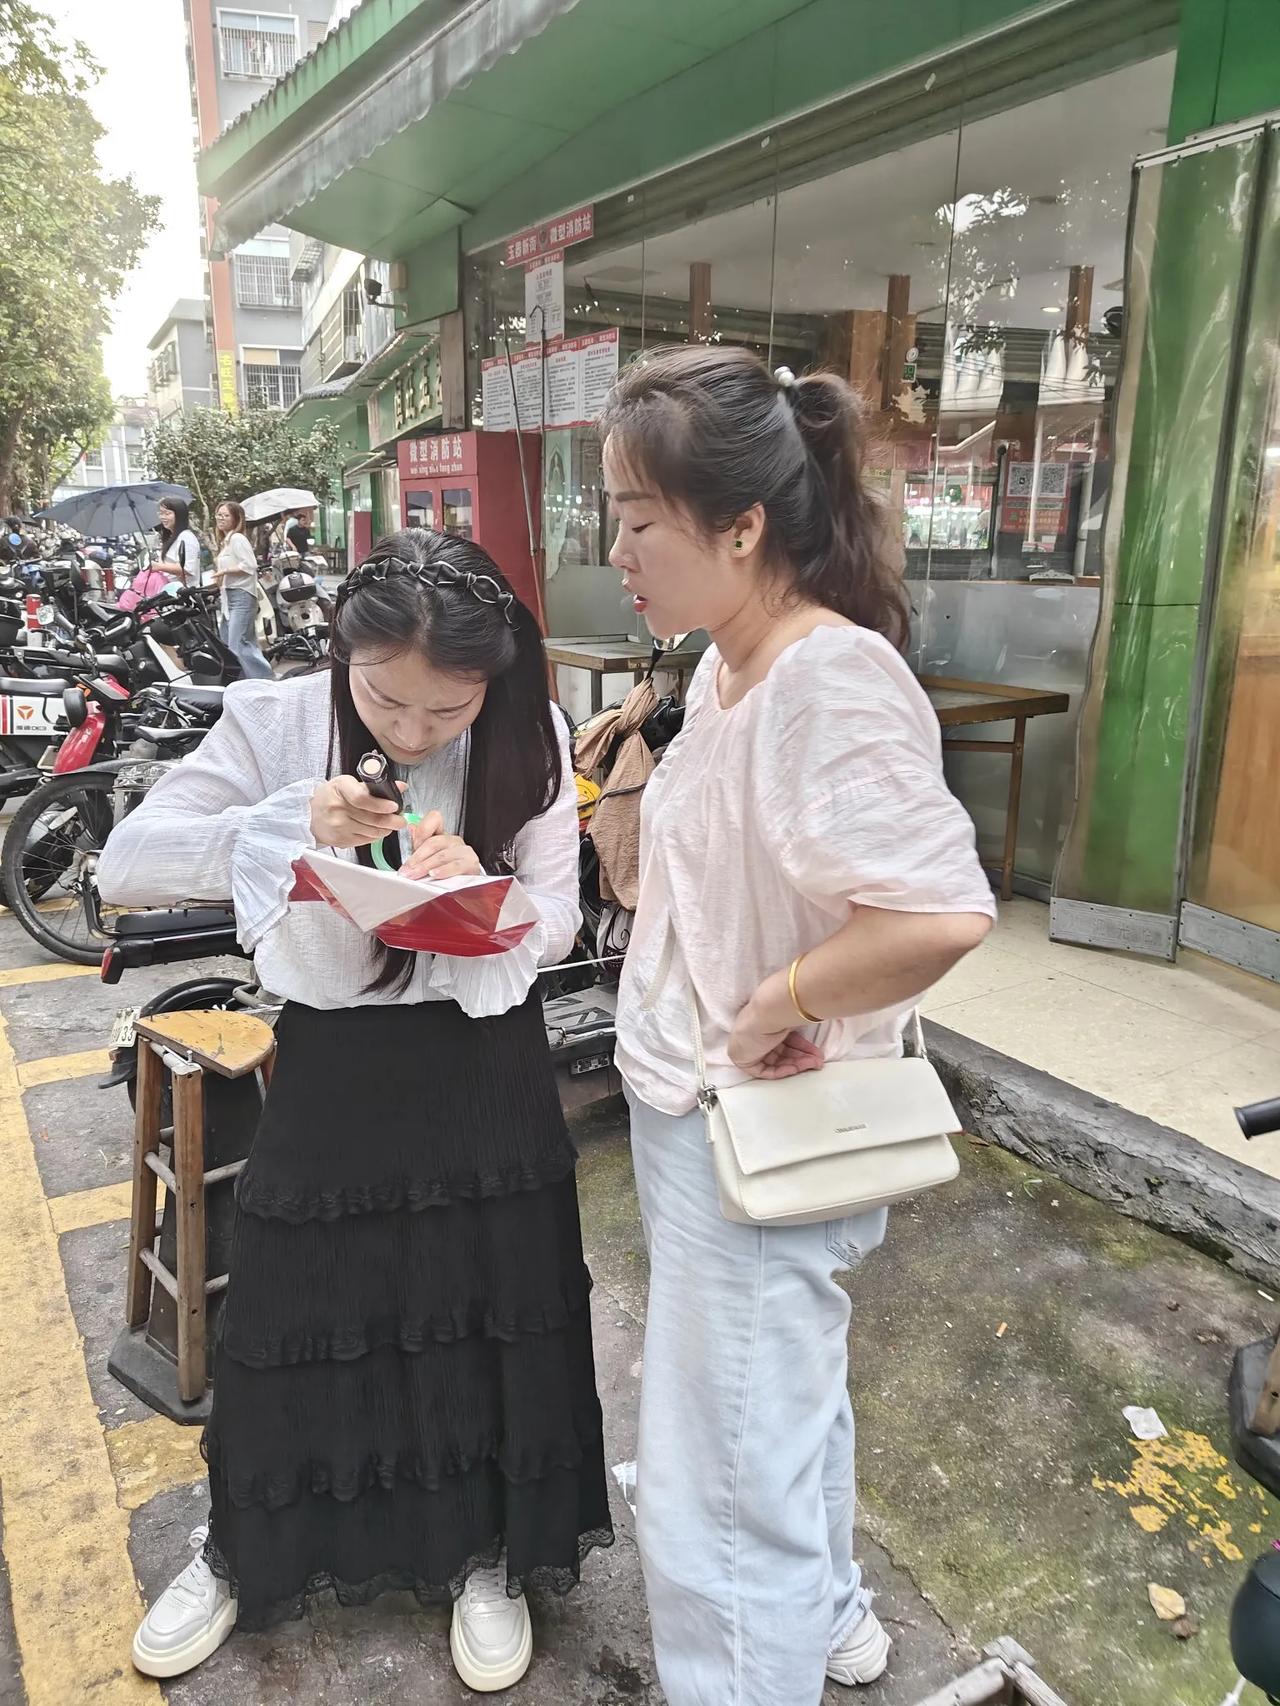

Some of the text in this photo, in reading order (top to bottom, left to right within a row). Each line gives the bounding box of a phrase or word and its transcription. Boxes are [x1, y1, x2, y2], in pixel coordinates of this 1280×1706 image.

[550, 212, 592, 244] 微型消防站
[409, 435, 462, 463] 微型消防站
